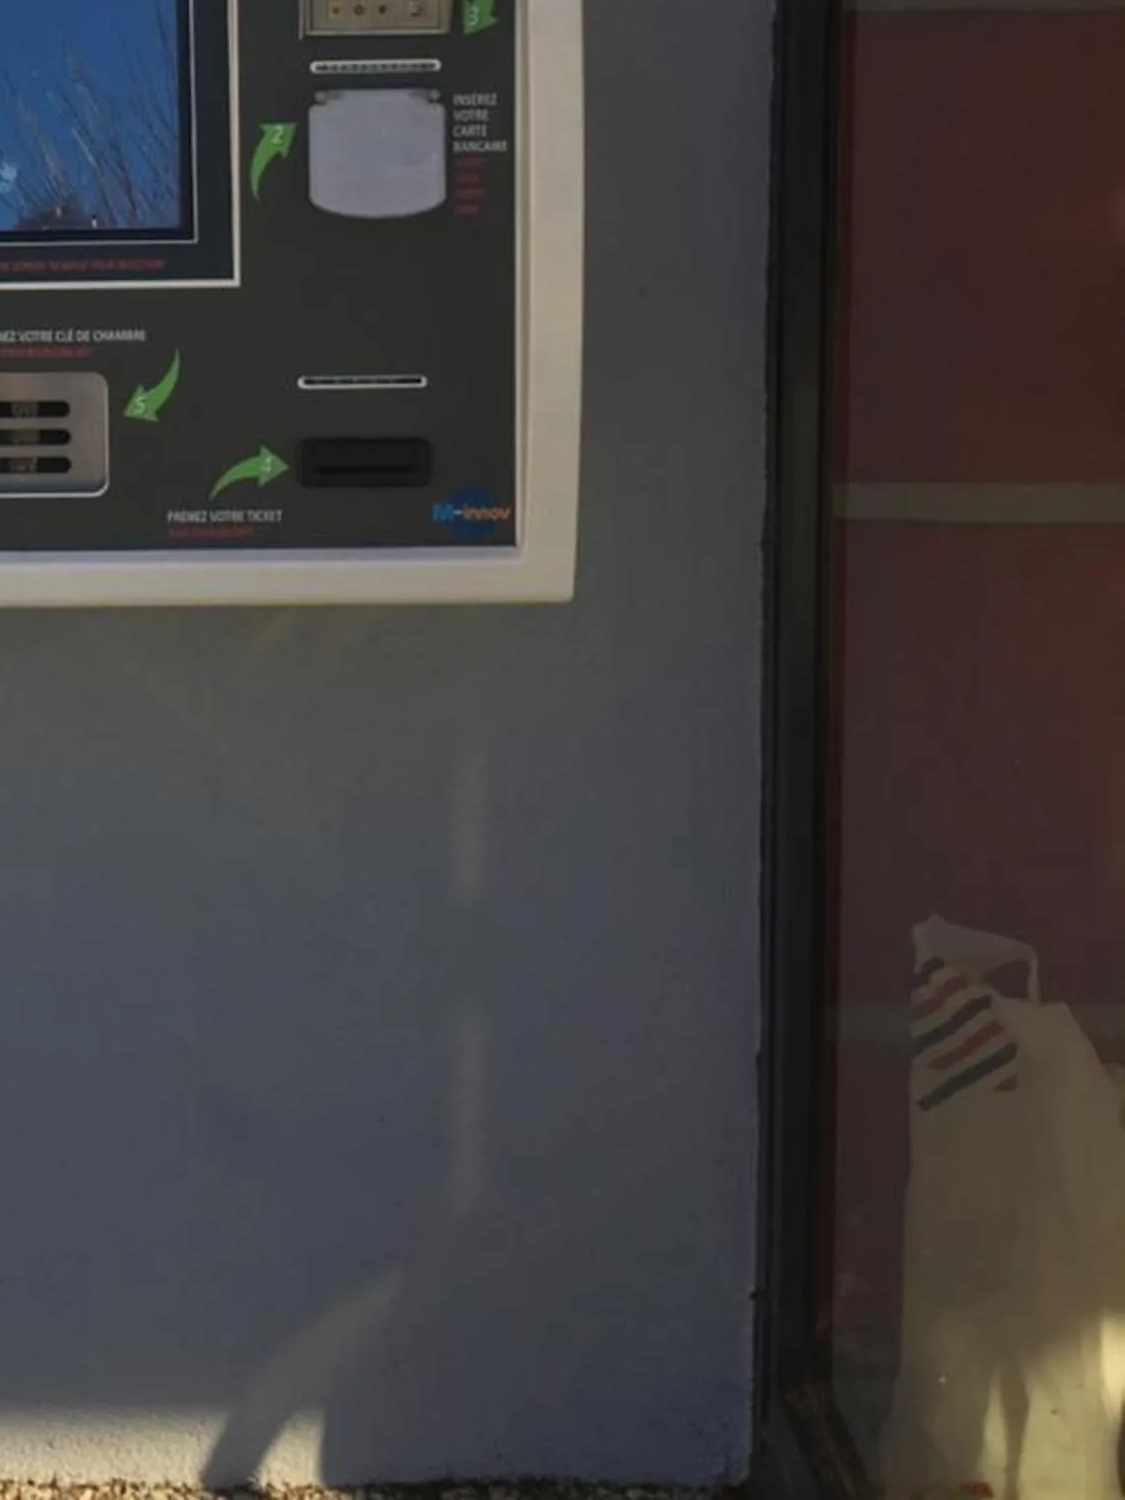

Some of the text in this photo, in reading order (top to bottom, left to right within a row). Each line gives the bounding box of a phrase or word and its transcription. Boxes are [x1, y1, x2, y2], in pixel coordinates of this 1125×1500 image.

[271, 123, 284, 145] 2
[452, 124, 486, 138] CARTE
[18, 330, 53, 343] VOTRE
[76, 330, 90, 342] DE
[92, 329, 146, 342] CHAMBRE
[135, 397, 147, 414] 5
